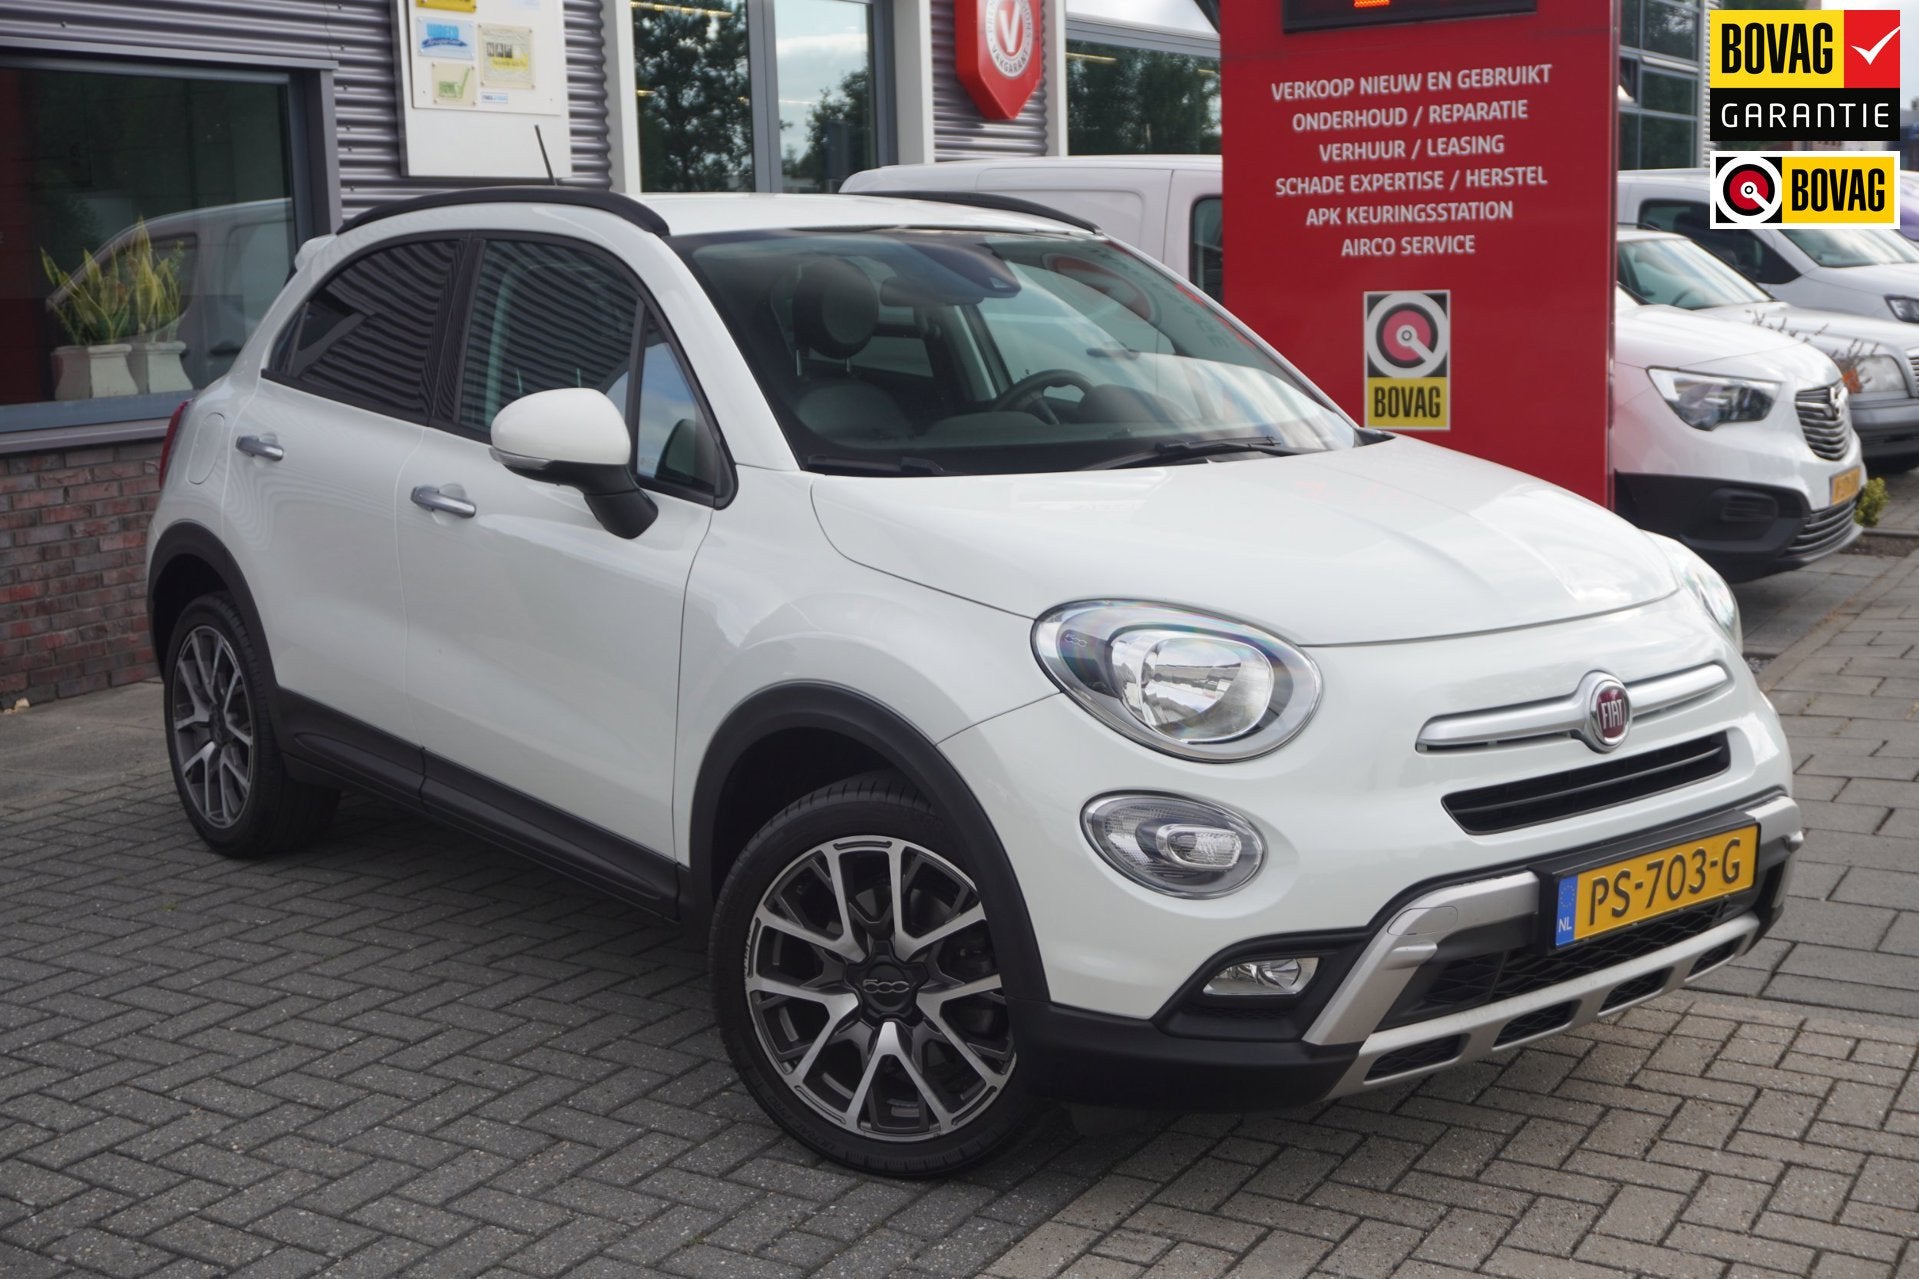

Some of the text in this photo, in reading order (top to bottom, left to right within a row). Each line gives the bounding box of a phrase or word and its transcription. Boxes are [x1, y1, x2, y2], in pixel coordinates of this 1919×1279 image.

[1271, 64, 1552, 101] VERKOOP NIEUW EN GEBRUIKT
[1292, 100, 1528, 132] ONDERHOUD / REPARATIE
[1319, 135, 1505, 162] VERHUUR / LEASING
[1275, 166, 1548, 197] SCHADE EXPERTISE / HERSTEL
[1306, 201, 1513, 226] APK KEURINGSSTATION
[1341, 235, 1476, 257] AIRCO SERVICE
[1374, 386, 1441, 418] BOVAG
[1601, 698, 1625, 729] FIAT
[1589, 838, 1741, 926] PS-703-G
[1558, 916, 1572, 933] NL
[863, 979, 910, 994] 500
